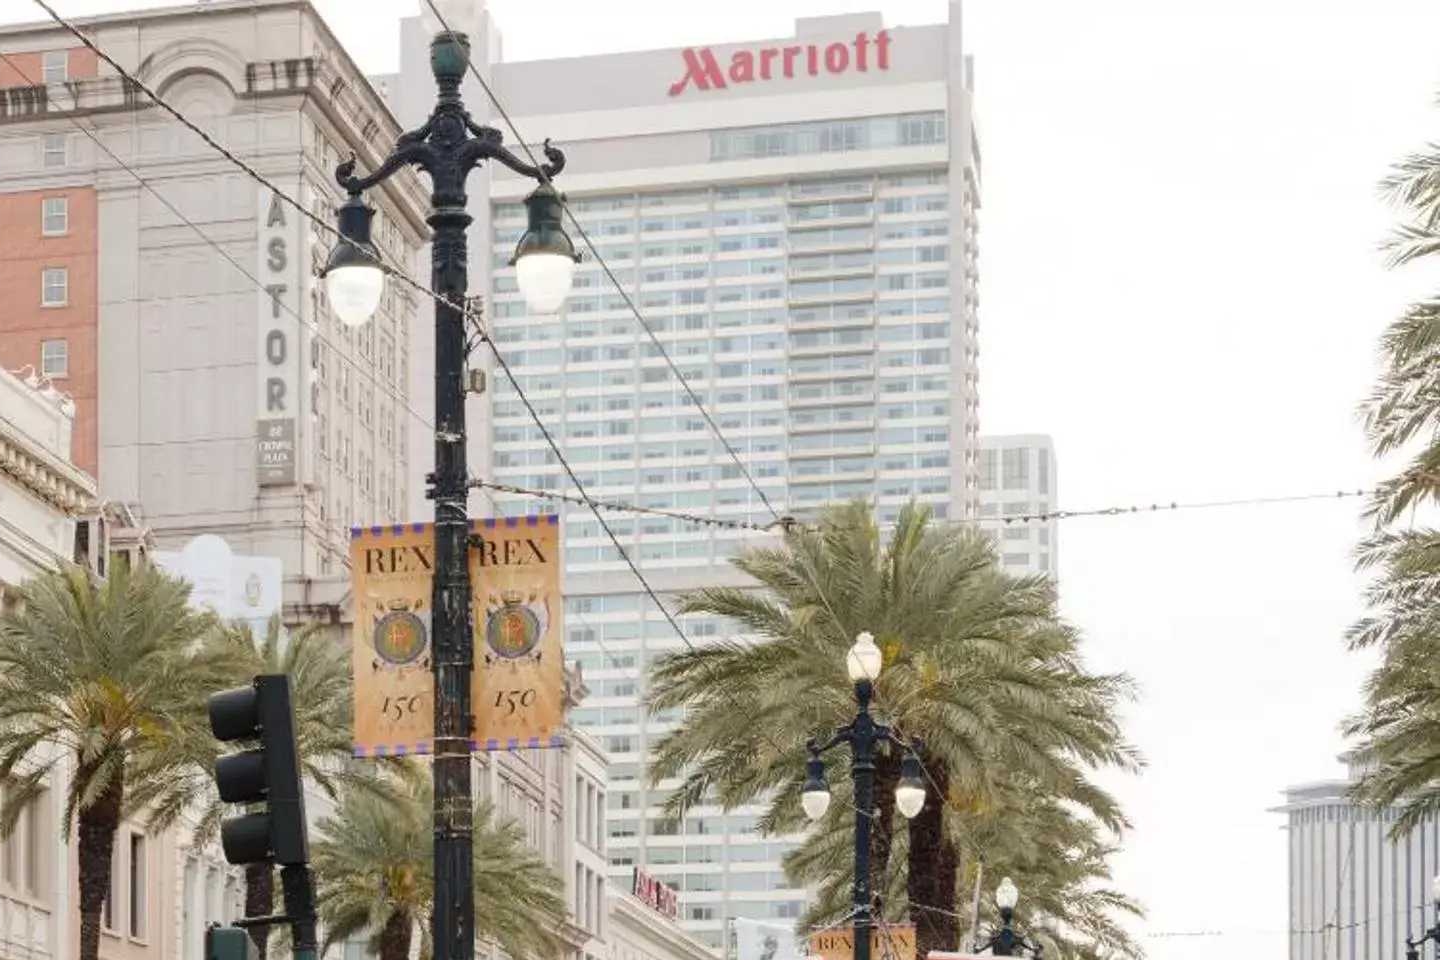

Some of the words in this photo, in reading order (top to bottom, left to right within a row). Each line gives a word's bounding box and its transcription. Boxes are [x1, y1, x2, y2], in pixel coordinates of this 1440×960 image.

[667, 29, 892, 97] Marriott
[266, 191, 288, 413] ASTOR
[365, 545, 432, 574] REX
[477, 538, 548, 567] REX
[495, 688, 538, 715] 150
